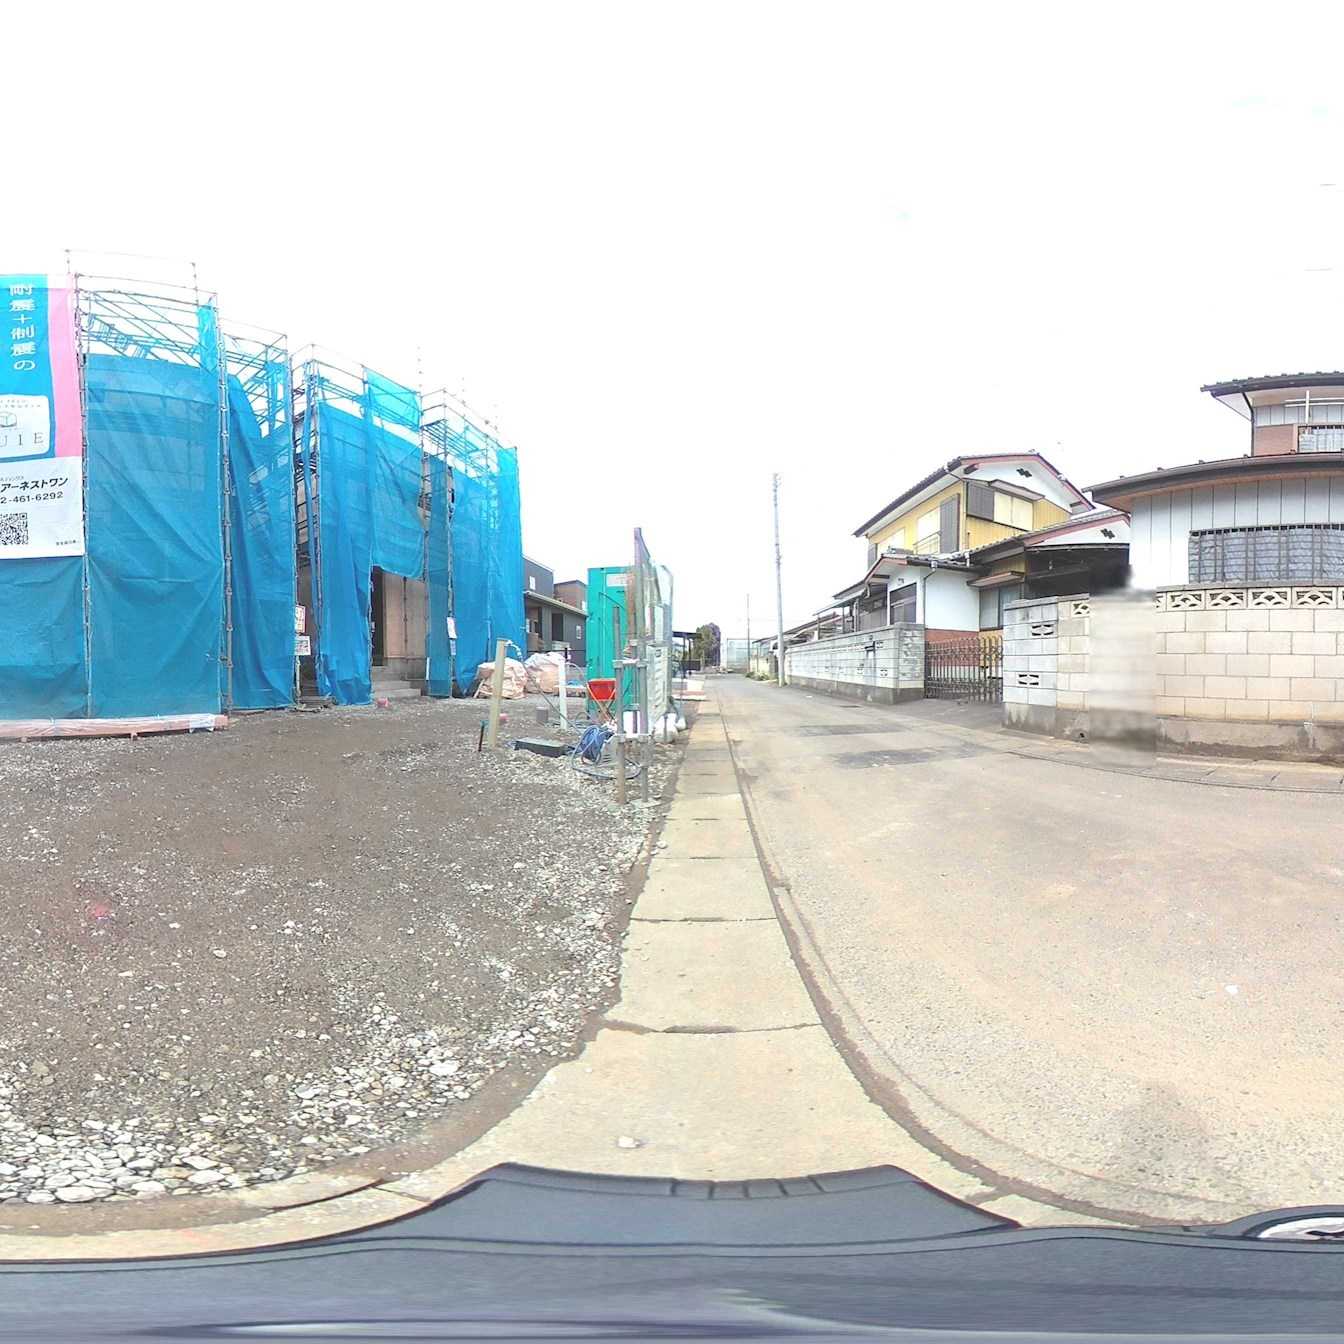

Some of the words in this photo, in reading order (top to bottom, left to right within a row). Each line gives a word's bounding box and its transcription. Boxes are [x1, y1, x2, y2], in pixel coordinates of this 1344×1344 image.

[1, 477, 68, 493] アーネストワン
